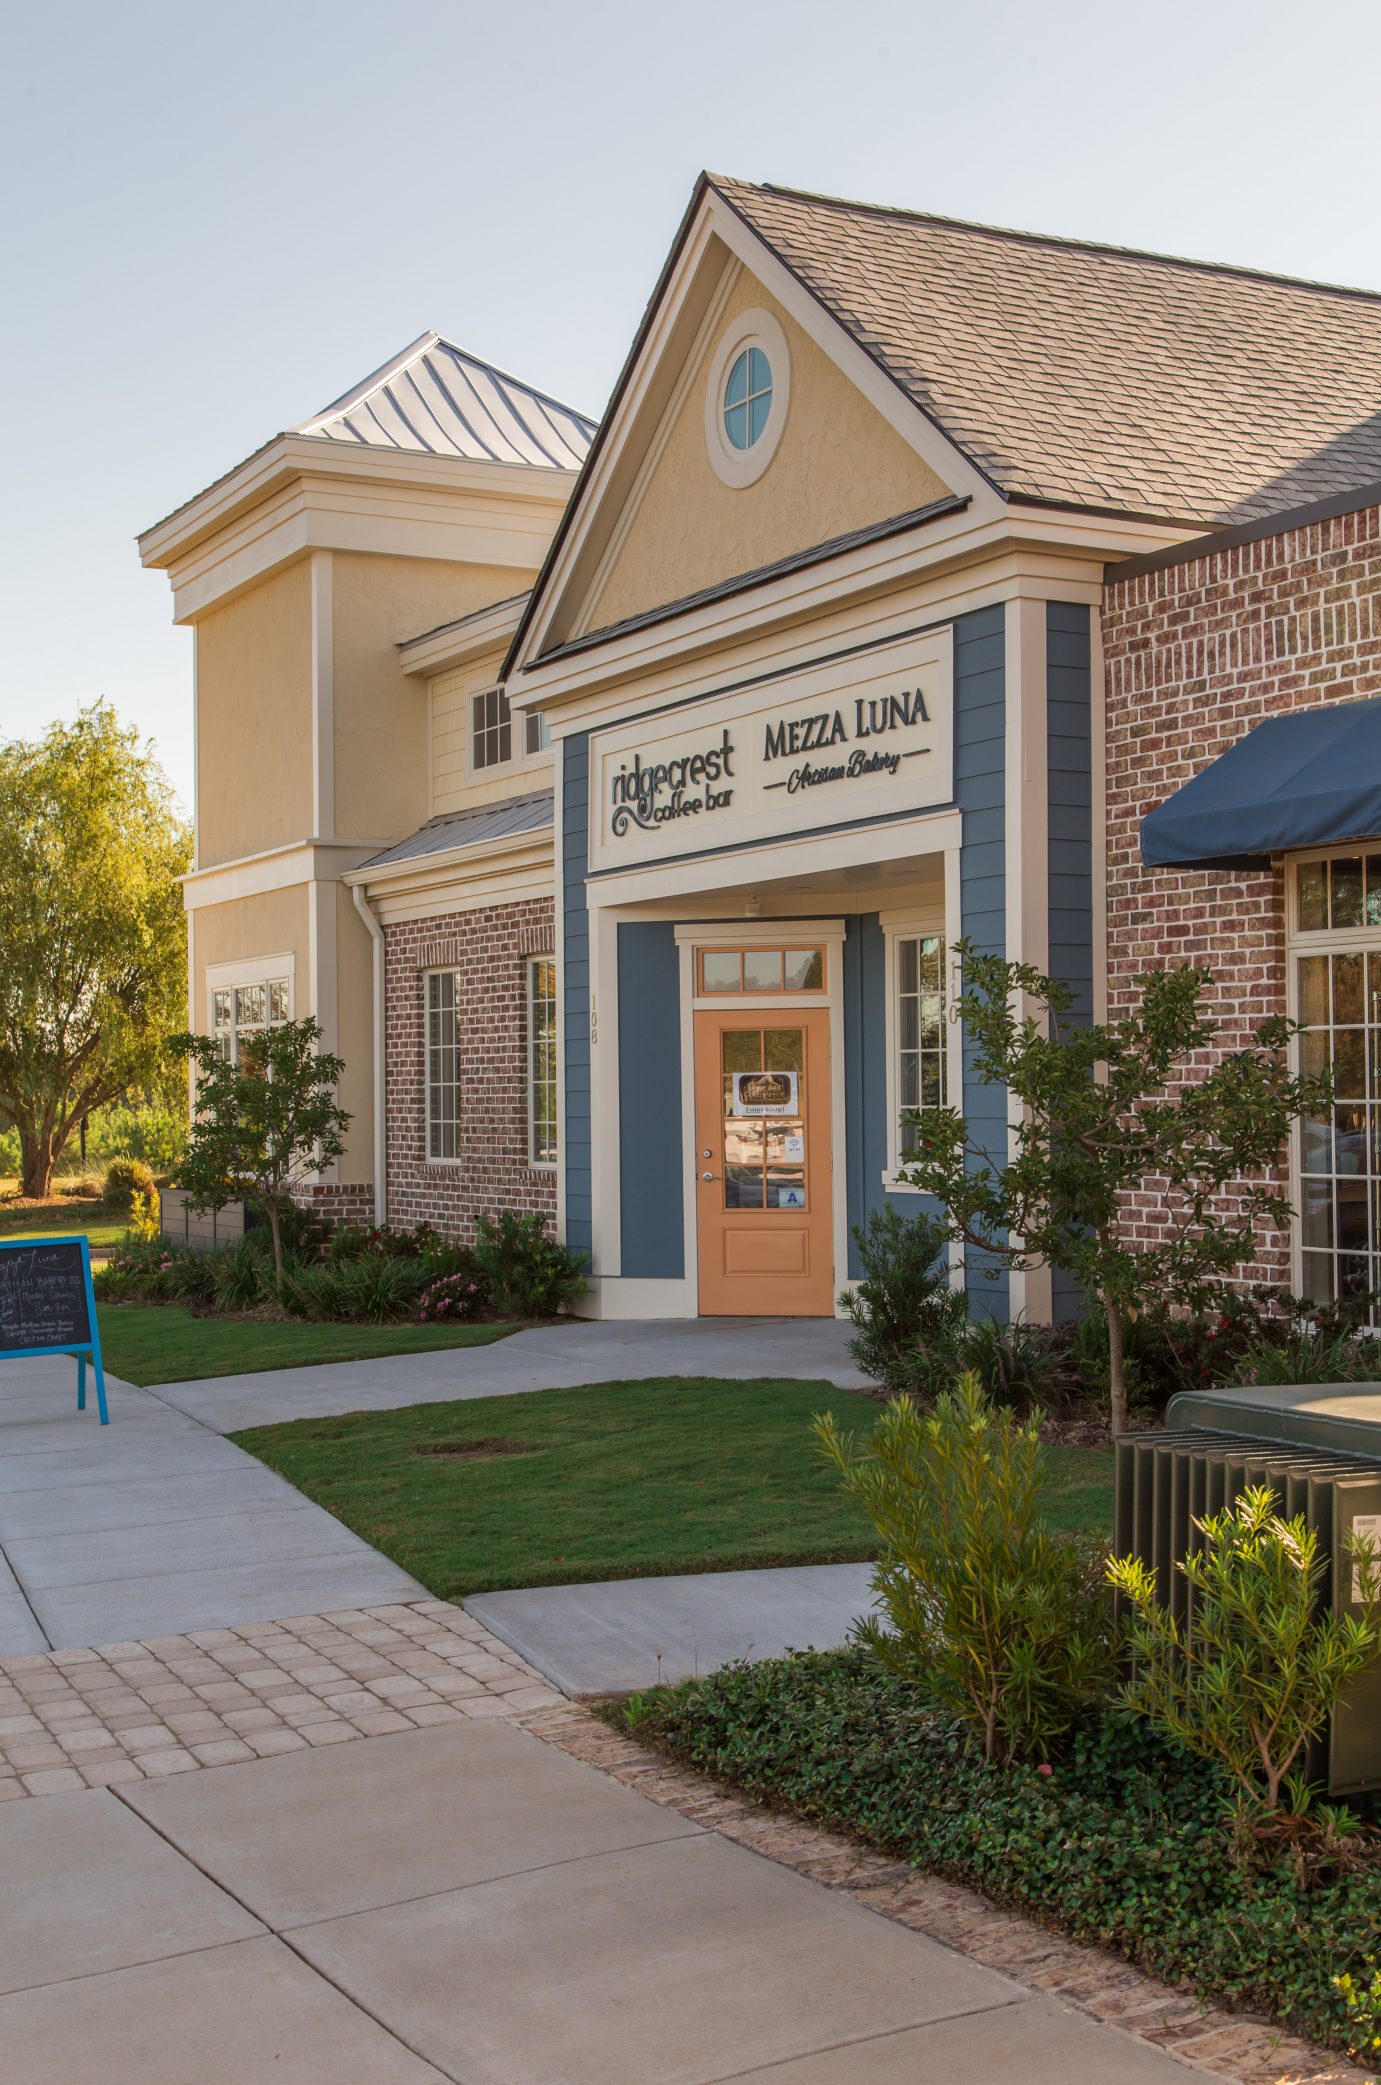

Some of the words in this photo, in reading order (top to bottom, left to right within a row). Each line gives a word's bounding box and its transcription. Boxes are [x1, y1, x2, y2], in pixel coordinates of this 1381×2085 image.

[763, 710, 848, 761] MEZZA
[854, 687, 931, 738] LUNA
[611, 728, 734, 821] ridgecrest
[787, 761, 846, 794] Artisan
[847, 749, 901, 776] Bakery
[653, 789, 703, 822] coffee
[705, 782, 734, 811] bar
[745, 1106, 765, 1114] Enter
[787, 1192, 798, 1203] A
